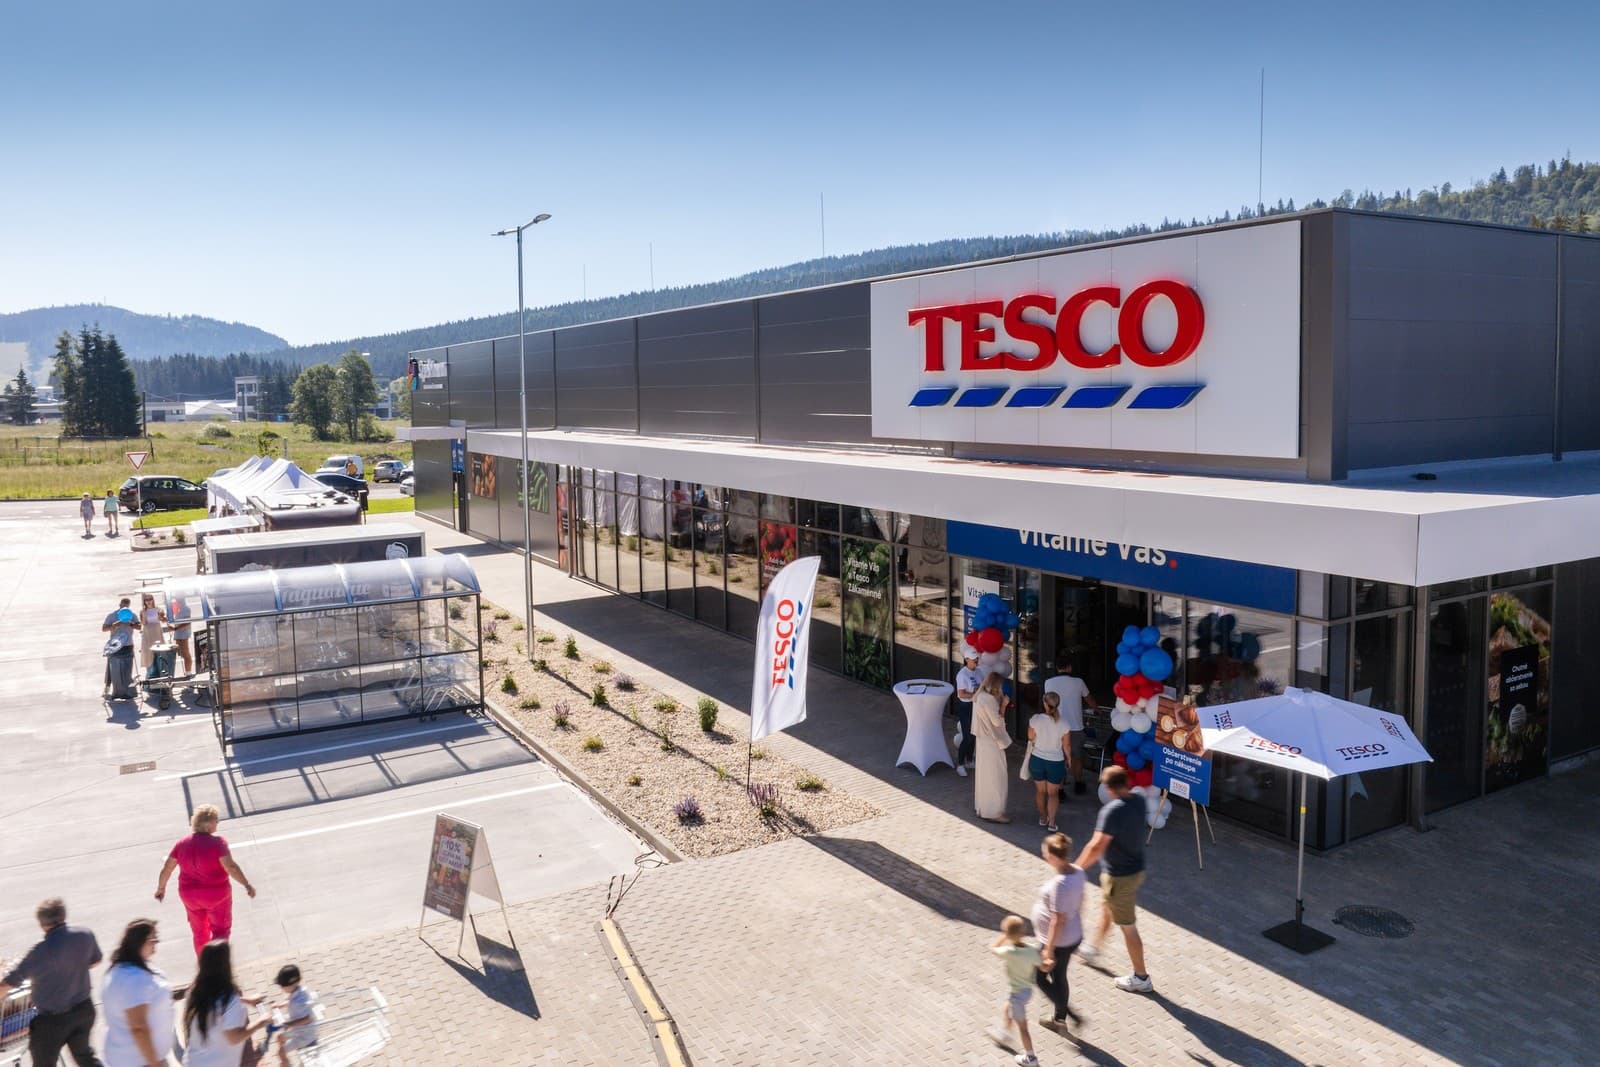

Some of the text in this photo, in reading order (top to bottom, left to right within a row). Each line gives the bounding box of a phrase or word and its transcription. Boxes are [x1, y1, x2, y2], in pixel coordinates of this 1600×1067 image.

[908, 280, 1205, 372] TESCO
[853, 571, 870, 583] Tesco
[772, 599, 795, 688] TESCO
[1249, 737, 1302, 755] TESCO
[1336, 743, 1386, 757] TESCO
[1162, 746, 1202, 766] Občerstvenie
